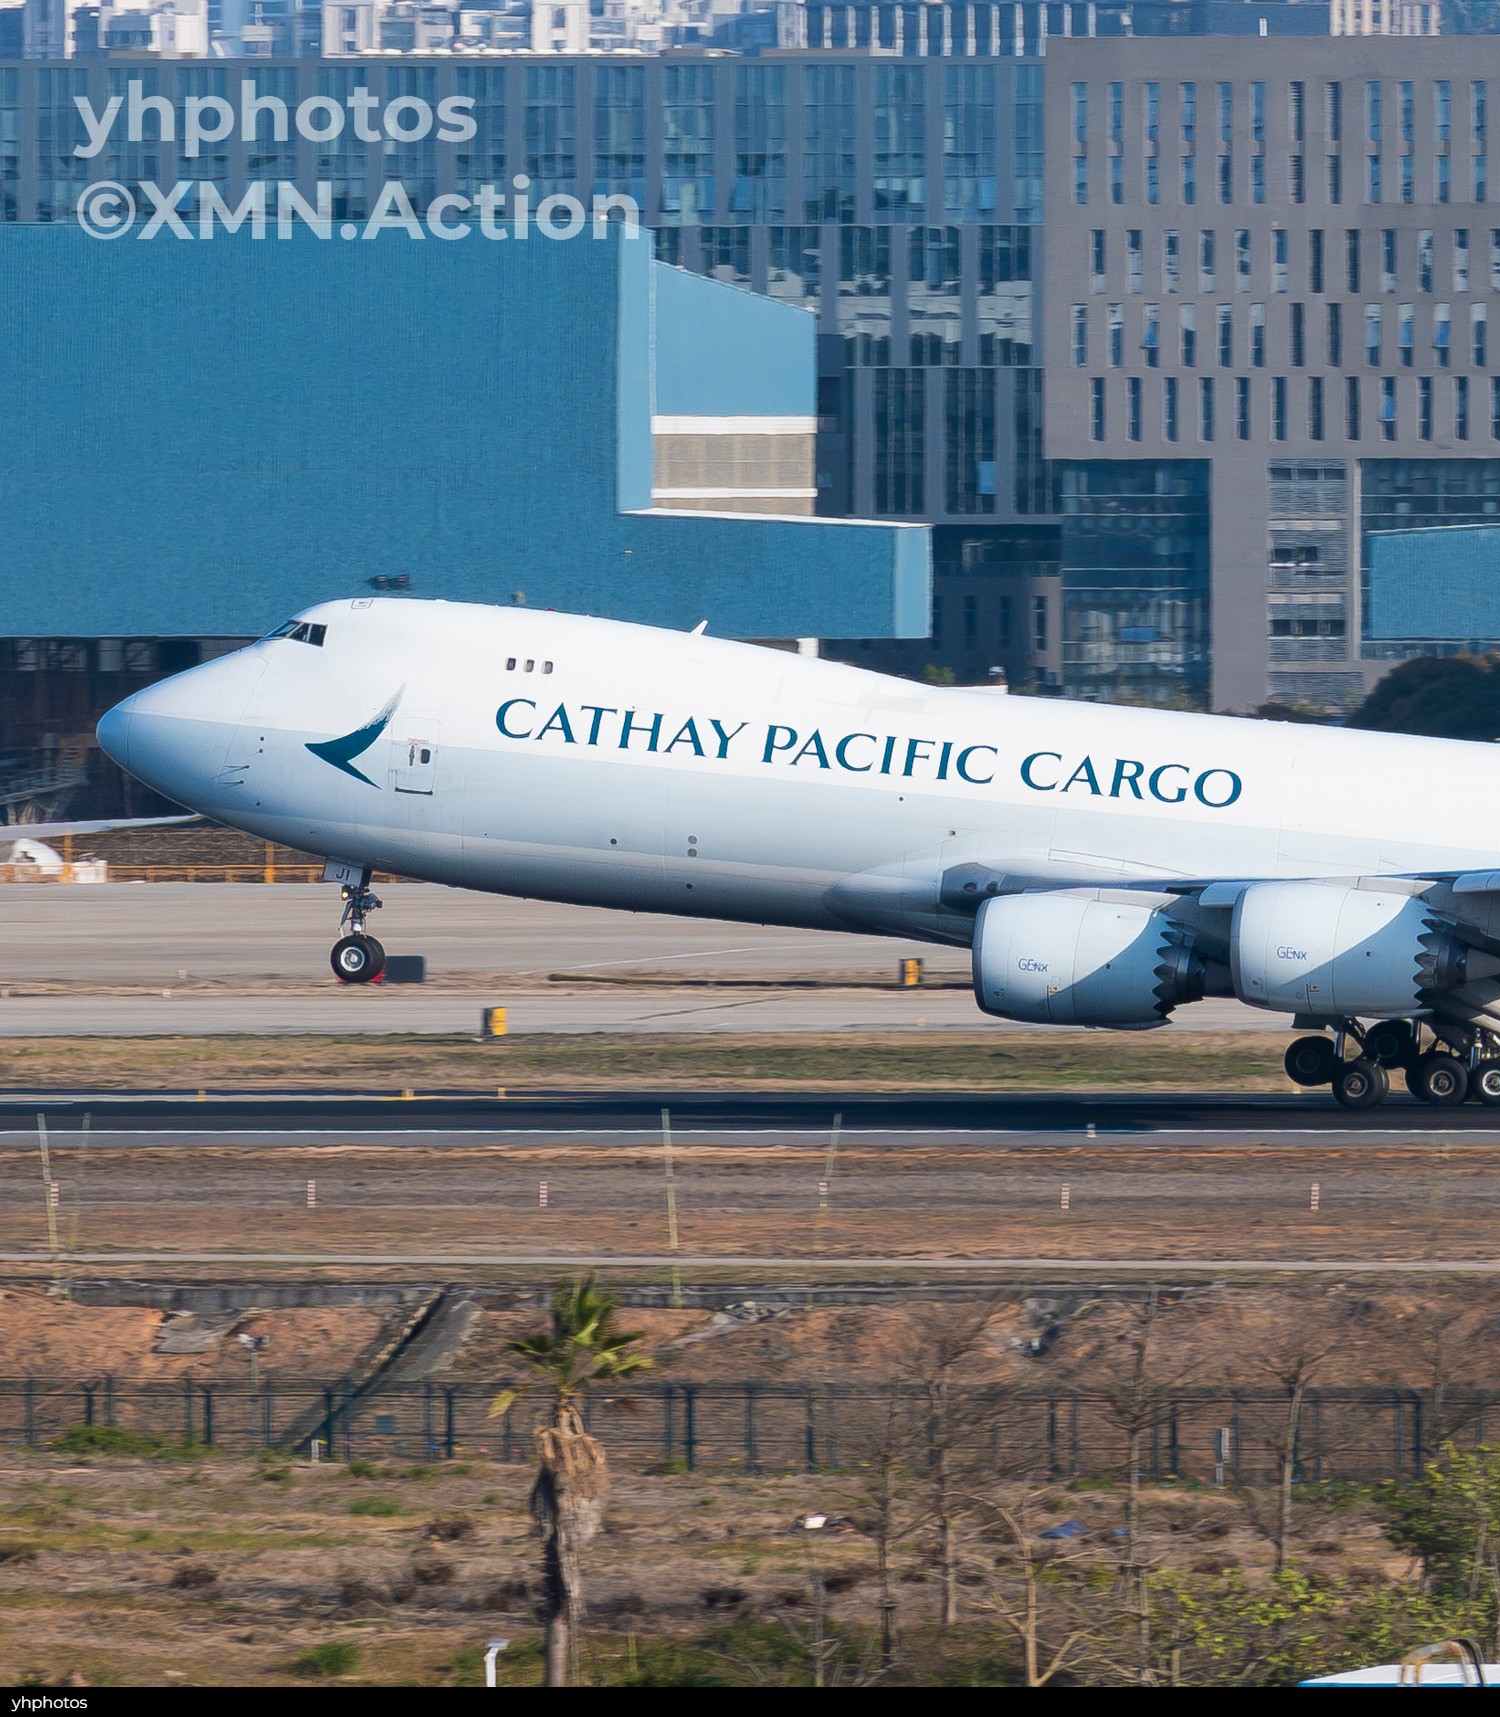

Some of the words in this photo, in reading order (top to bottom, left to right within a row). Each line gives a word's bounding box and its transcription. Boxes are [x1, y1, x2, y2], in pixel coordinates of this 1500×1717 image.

[495, 698, 749, 759] CATHAY
[761, 724, 998, 785] PACIFIC
[1020, 751, 1242, 808] CARGO
[336, 868, 350, 881] JI
